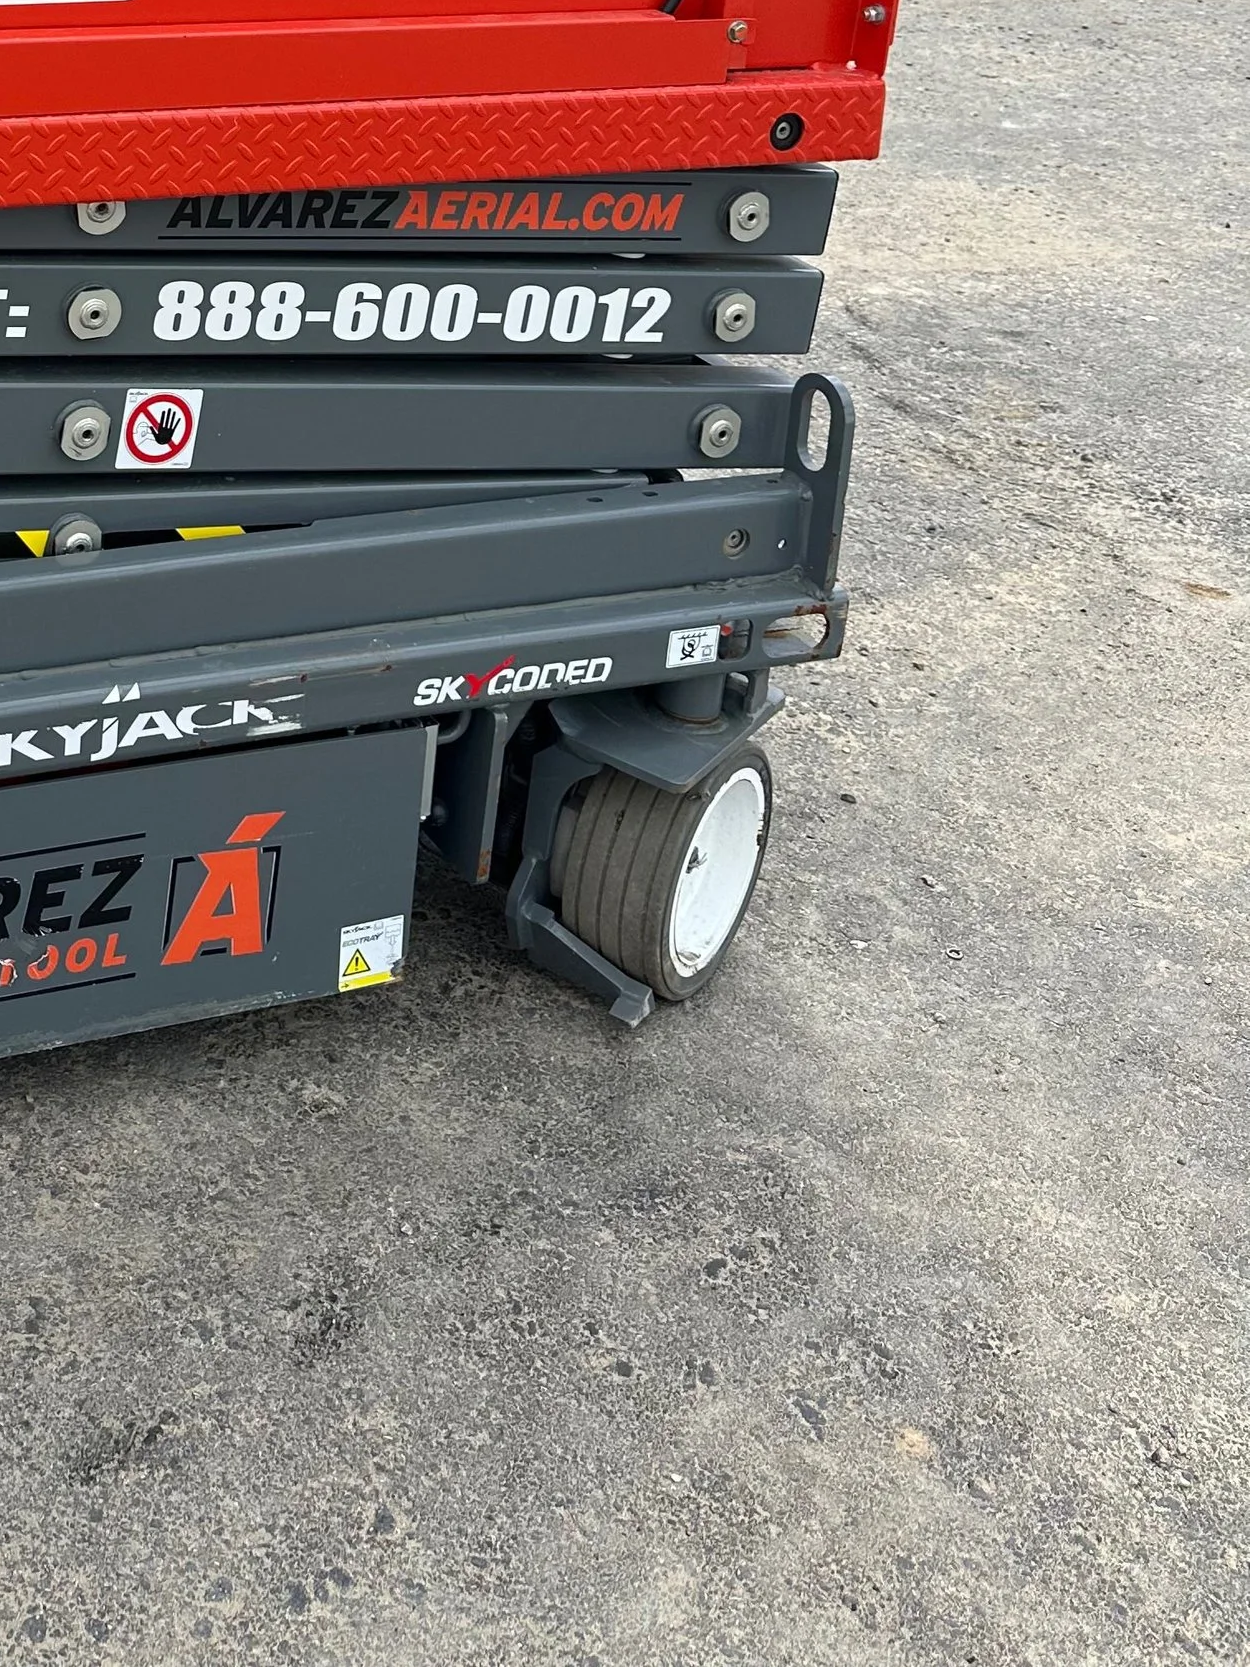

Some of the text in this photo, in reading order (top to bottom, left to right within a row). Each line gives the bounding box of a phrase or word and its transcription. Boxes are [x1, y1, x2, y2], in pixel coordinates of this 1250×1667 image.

[153, 280, 673, 344] 888-600-0012
[412, 655, 614, 709] SKYCODED
[161, 811, 286, 966] Á
[342, 931, 384, 948] ECOTRAY
